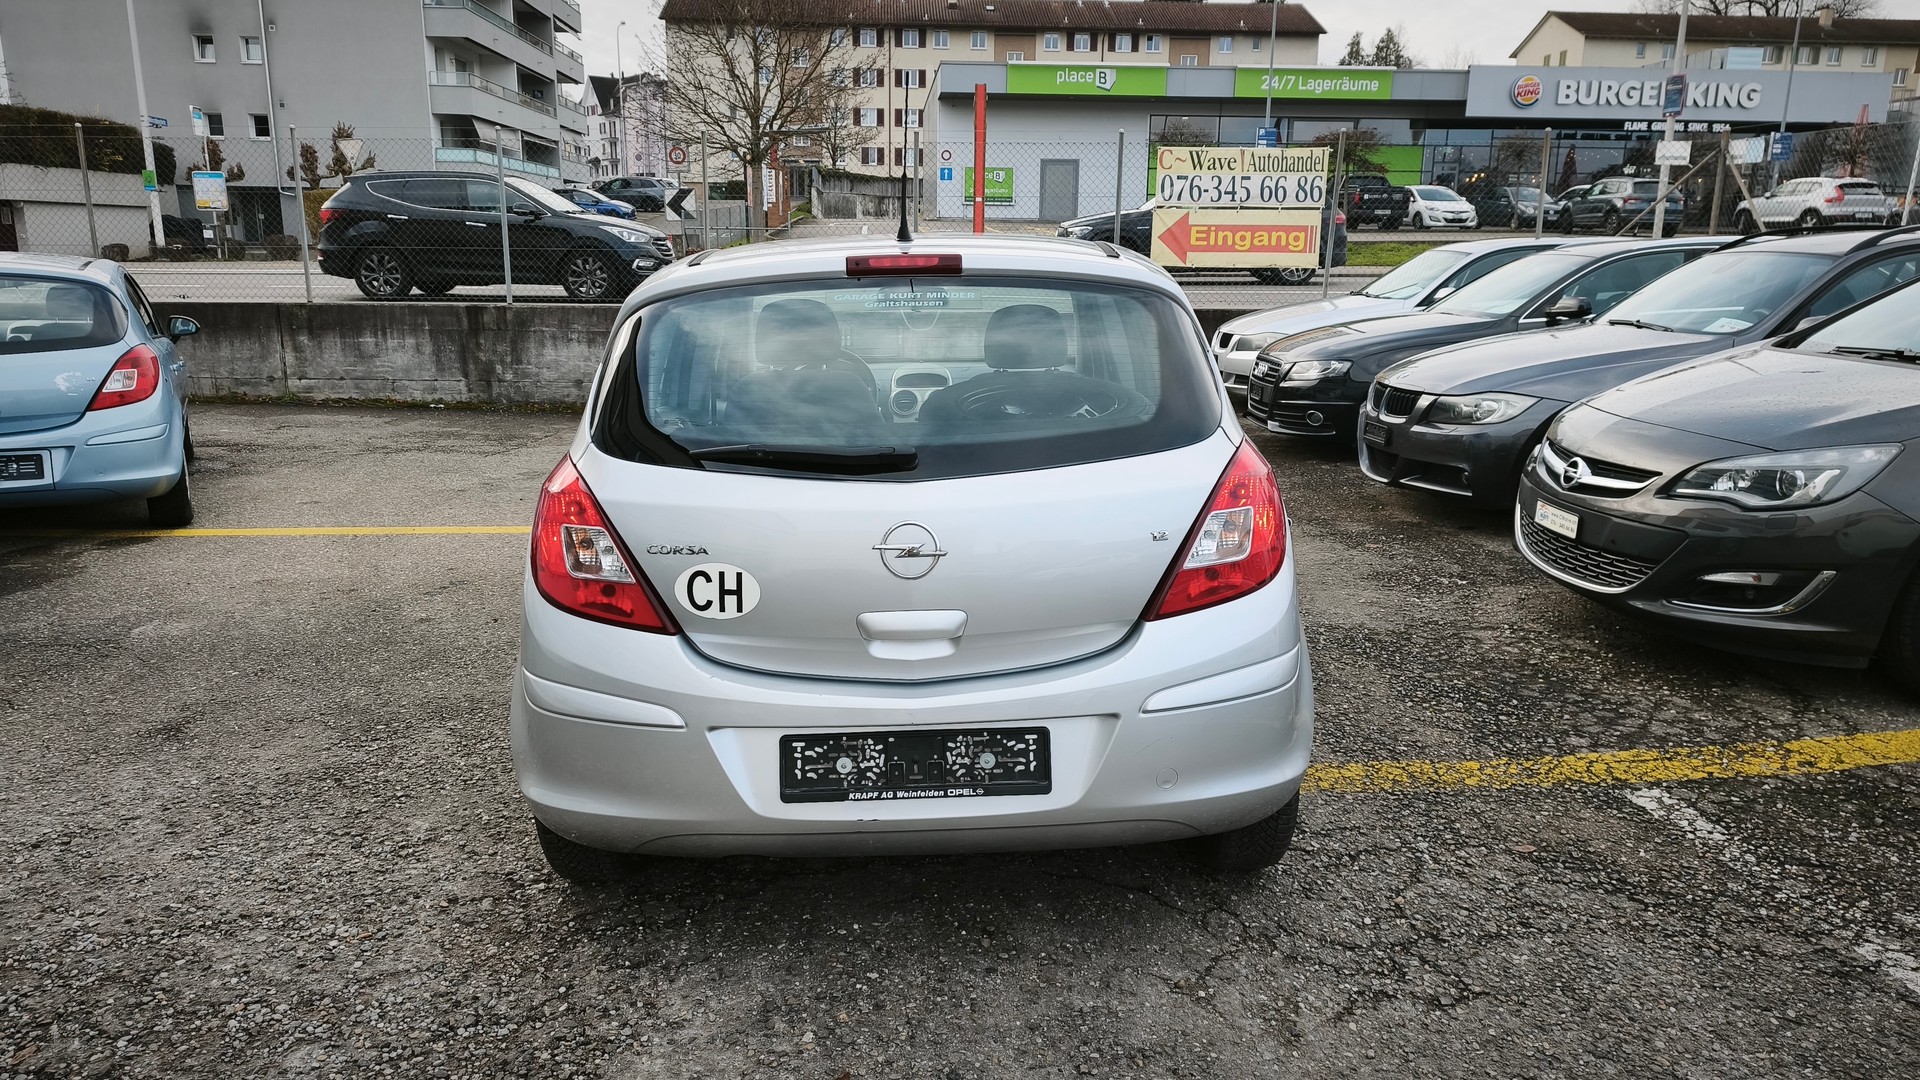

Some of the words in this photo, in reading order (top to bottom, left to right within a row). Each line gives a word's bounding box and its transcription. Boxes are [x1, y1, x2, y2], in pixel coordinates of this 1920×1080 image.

[1056, 67, 1094, 85] place
[1261, 75, 1296, 90] 24/7
[1298, 76, 1379, 93] Lagerräume
[1516, 88, 1541, 99] KING
[1686, 81, 1763, 109] KING
[1623, 121, 1648, 131] FLAME
[1687, 122, 1709, 132] SINCE
[1247, 149, 1325, 172] Autohandel
[1160, 174, 1251, 202] 076-345
[1259, 175, 1287, 203] 66
[1295, 175, 1323, 203] 86
[834, 292, 886, 301] GARAGE
[889, 291, 923, 300] KURT
[926, 291, 976, 299] MINDER
[646, 544, 711, 556] CORSA
[687, 570, 743, 613] CH
[849, 792, 879, 800] KRAPF
[880, 791, 894, 799] AG
[896, 790, 945, 798] Weinfelden
[947, 788, 977, 796] OPEL
